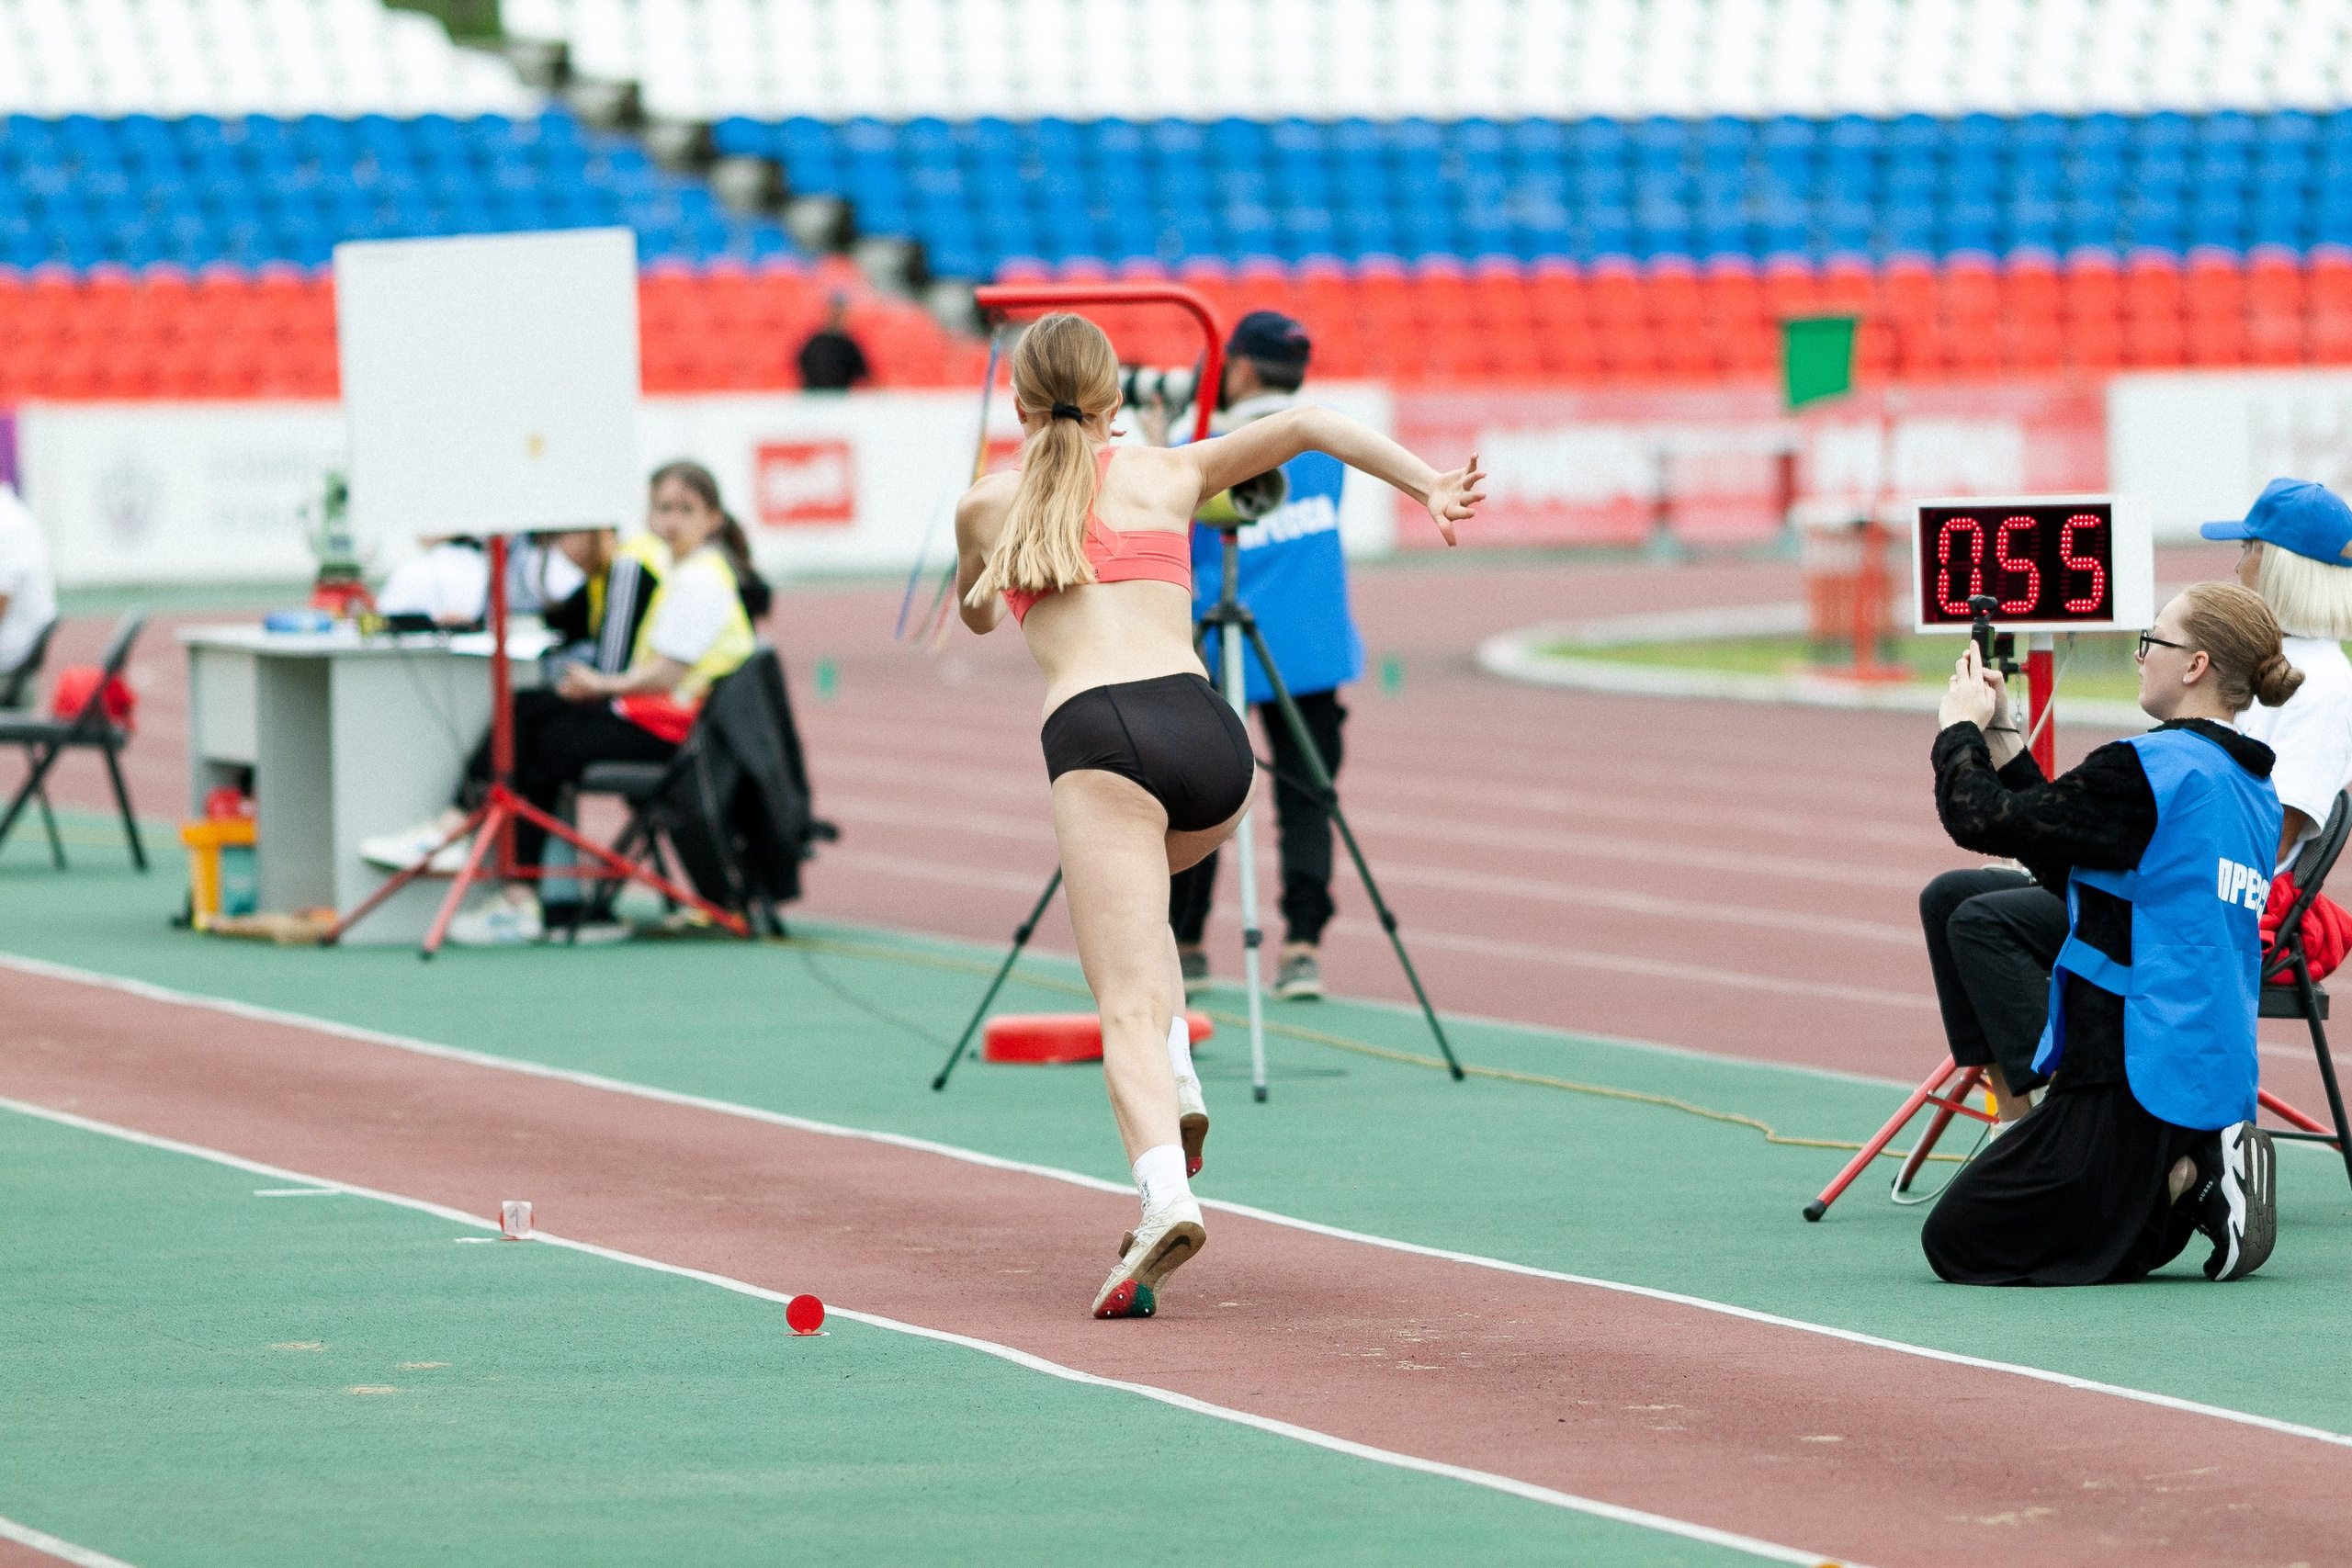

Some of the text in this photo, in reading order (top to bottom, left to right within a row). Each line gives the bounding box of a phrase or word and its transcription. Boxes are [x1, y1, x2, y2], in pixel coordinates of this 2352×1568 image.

[1937, 513, 2105, 615] 055
[2199, 1180, 2213, 1201] GUESS
[509, 1207, 519, 1228] 1
